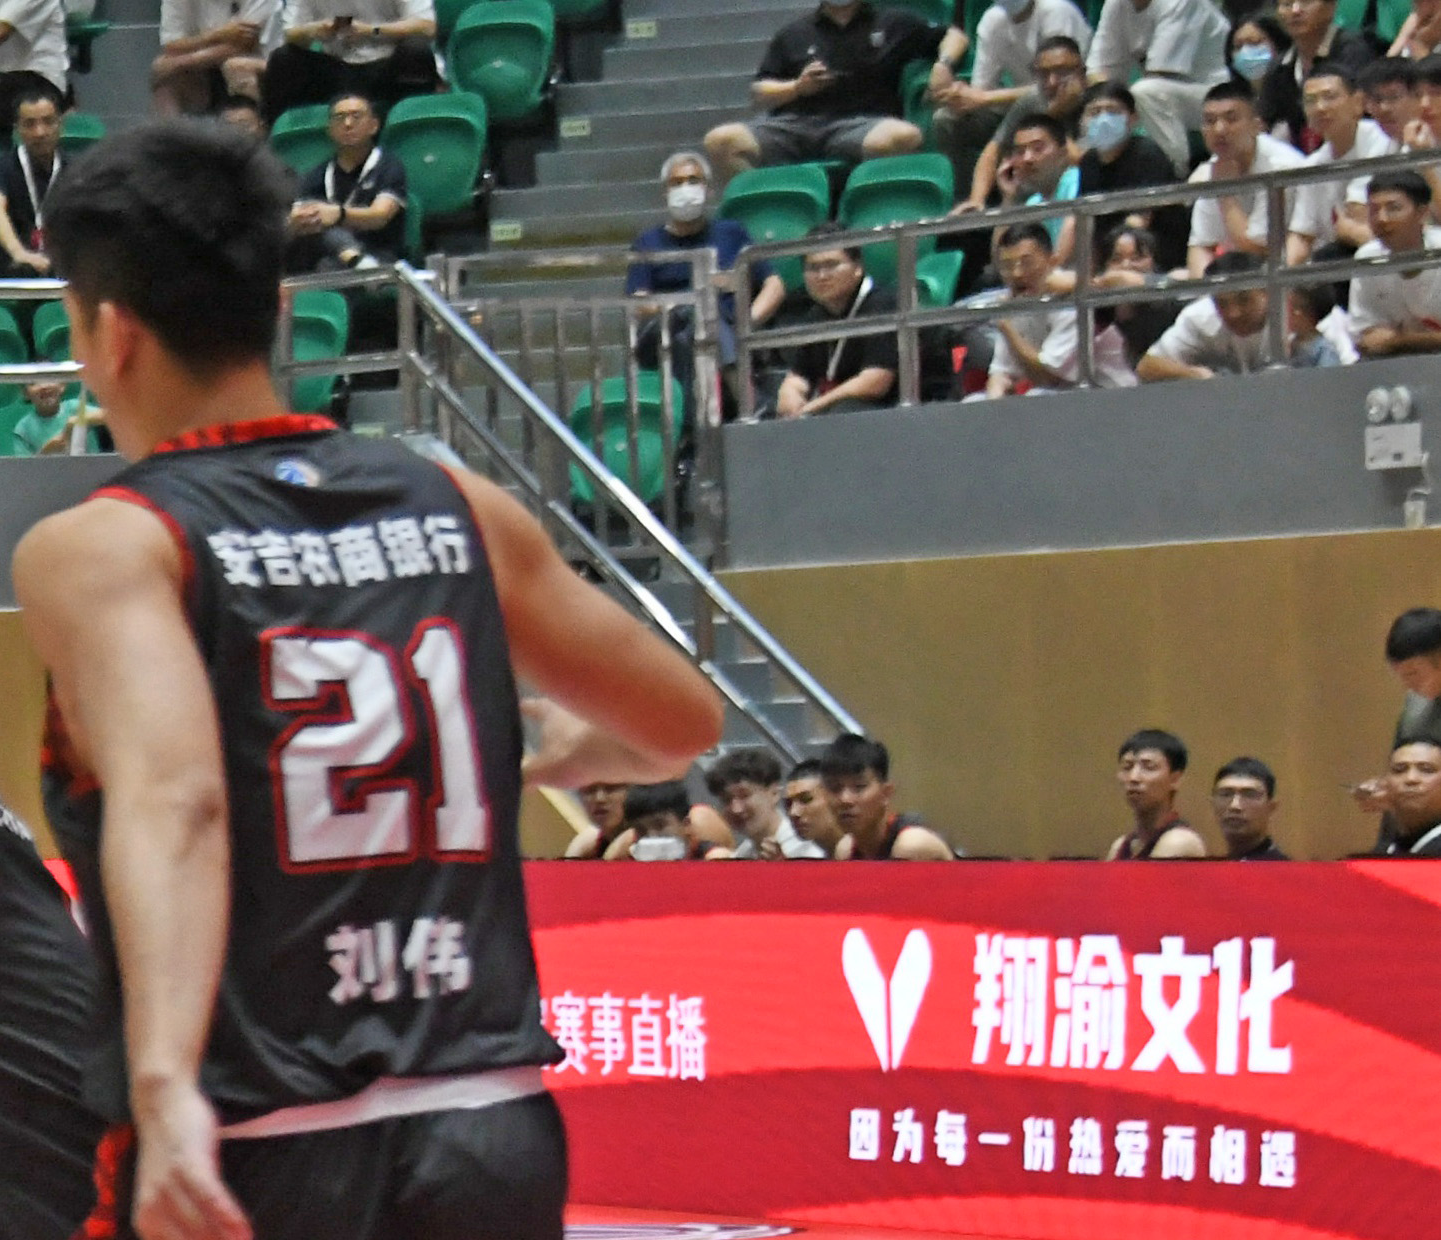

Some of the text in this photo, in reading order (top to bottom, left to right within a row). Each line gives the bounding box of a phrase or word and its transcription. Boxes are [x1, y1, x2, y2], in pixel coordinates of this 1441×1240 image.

[259, 616, 493, 875] 21
[325, 913, 473, 1005] 刘伟
[971, 933, 1295, 1076] 翔渝文化
[540, 990, 707, 1082] 赛事直播
[848, 1107, 1298, 1188] 因为每一份热爱而相遇
